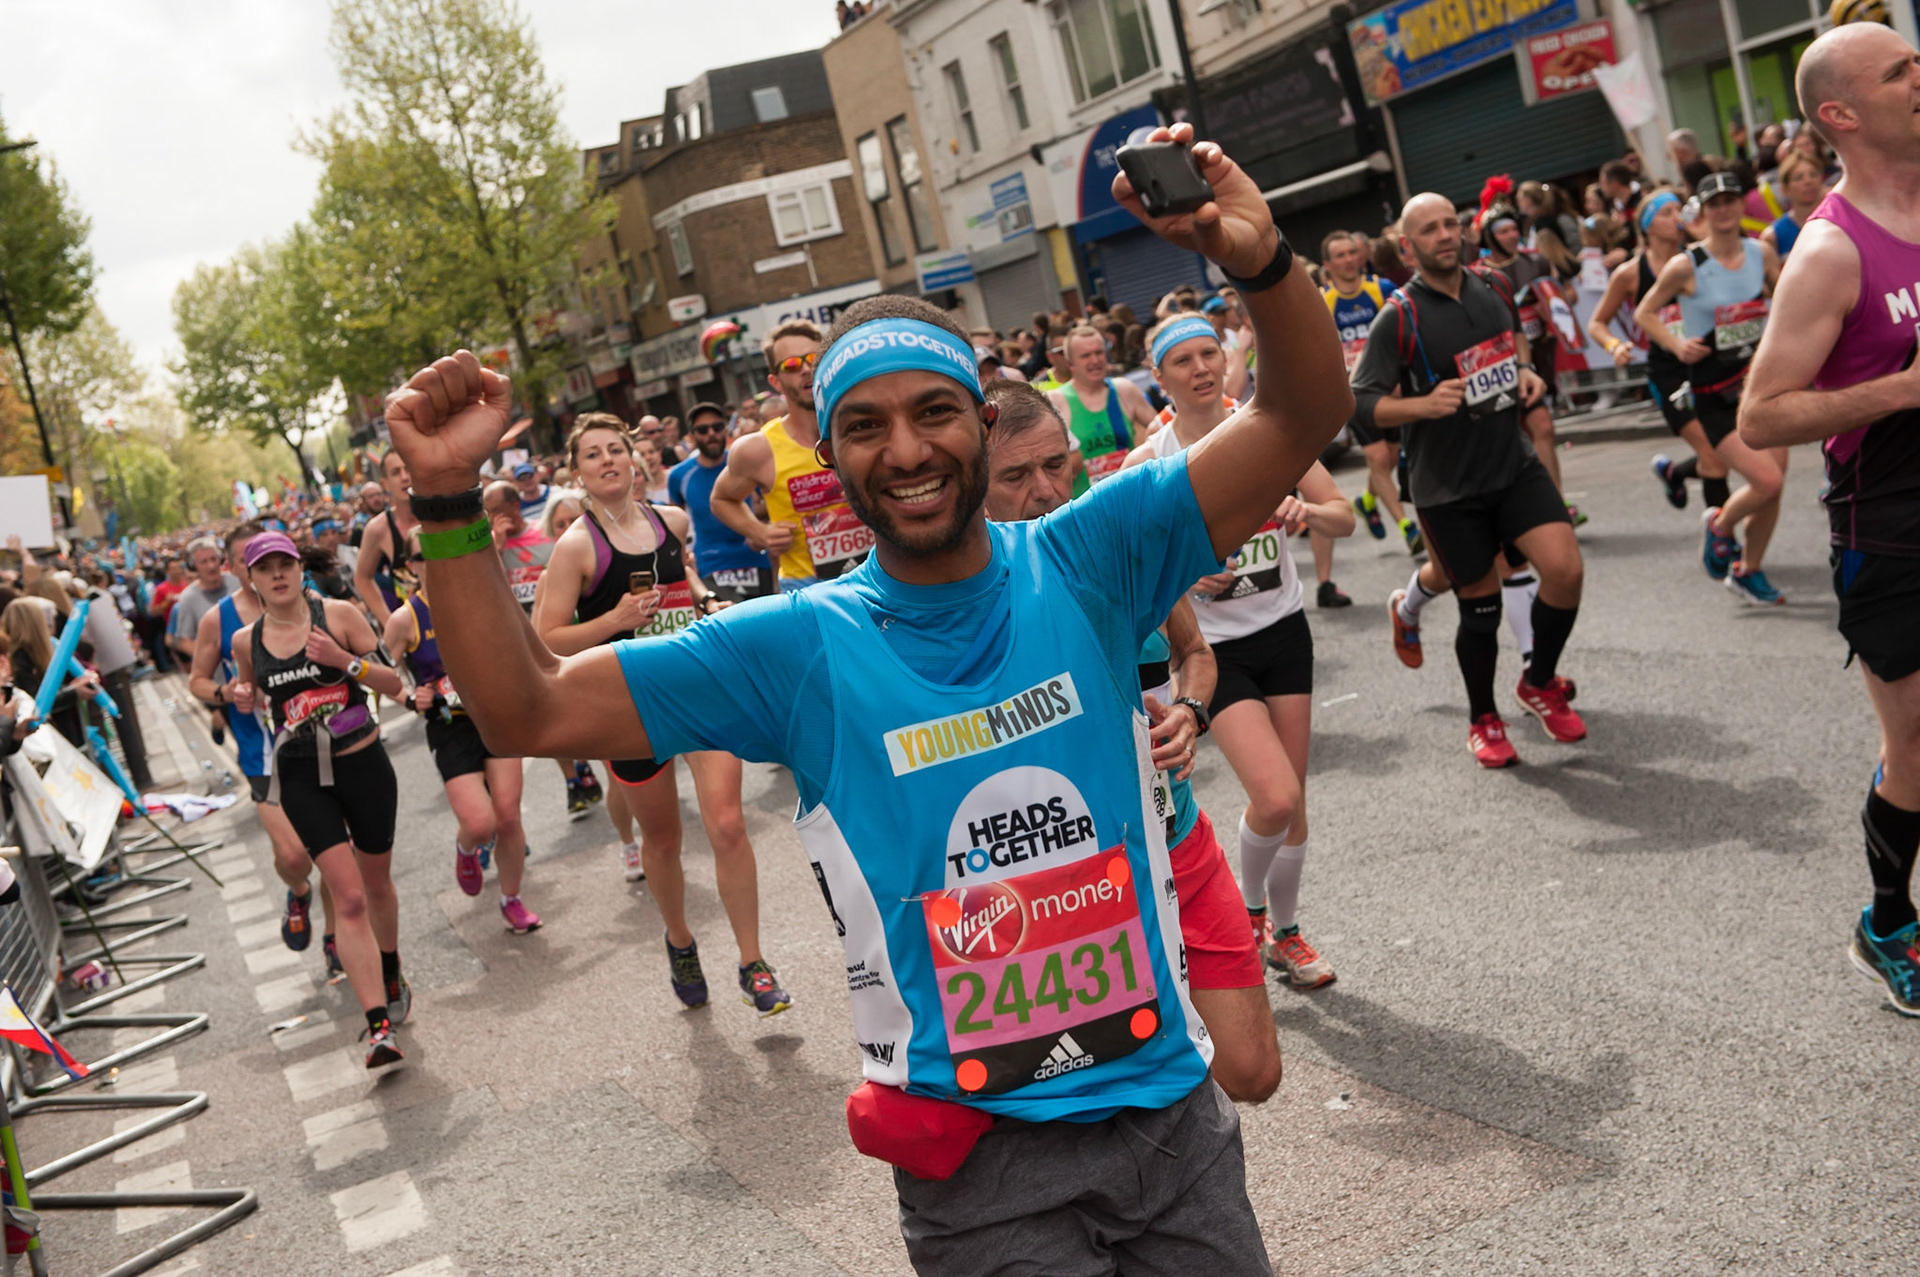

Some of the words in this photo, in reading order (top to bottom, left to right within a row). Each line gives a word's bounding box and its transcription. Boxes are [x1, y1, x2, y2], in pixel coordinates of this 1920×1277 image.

[1543, 70, 1597, 90] OPE
[822, 331, 977, 389] #HEADSTOGETHER
[1467, 362, 1518, 398] 1946
[789, 472, 837, 491] children
[813, 527, 876, 560] 37668
[267, 664, 322, 688] JEMMA
[968, 796, 1067, 848] HEADS
[948, 815, 1095, 878] TOGETHER
[944, 887, 1017, 955] Virgin
[946, 929, 1138, 1036] 24431
[1034, 1053, 1095, 1081] adidas
